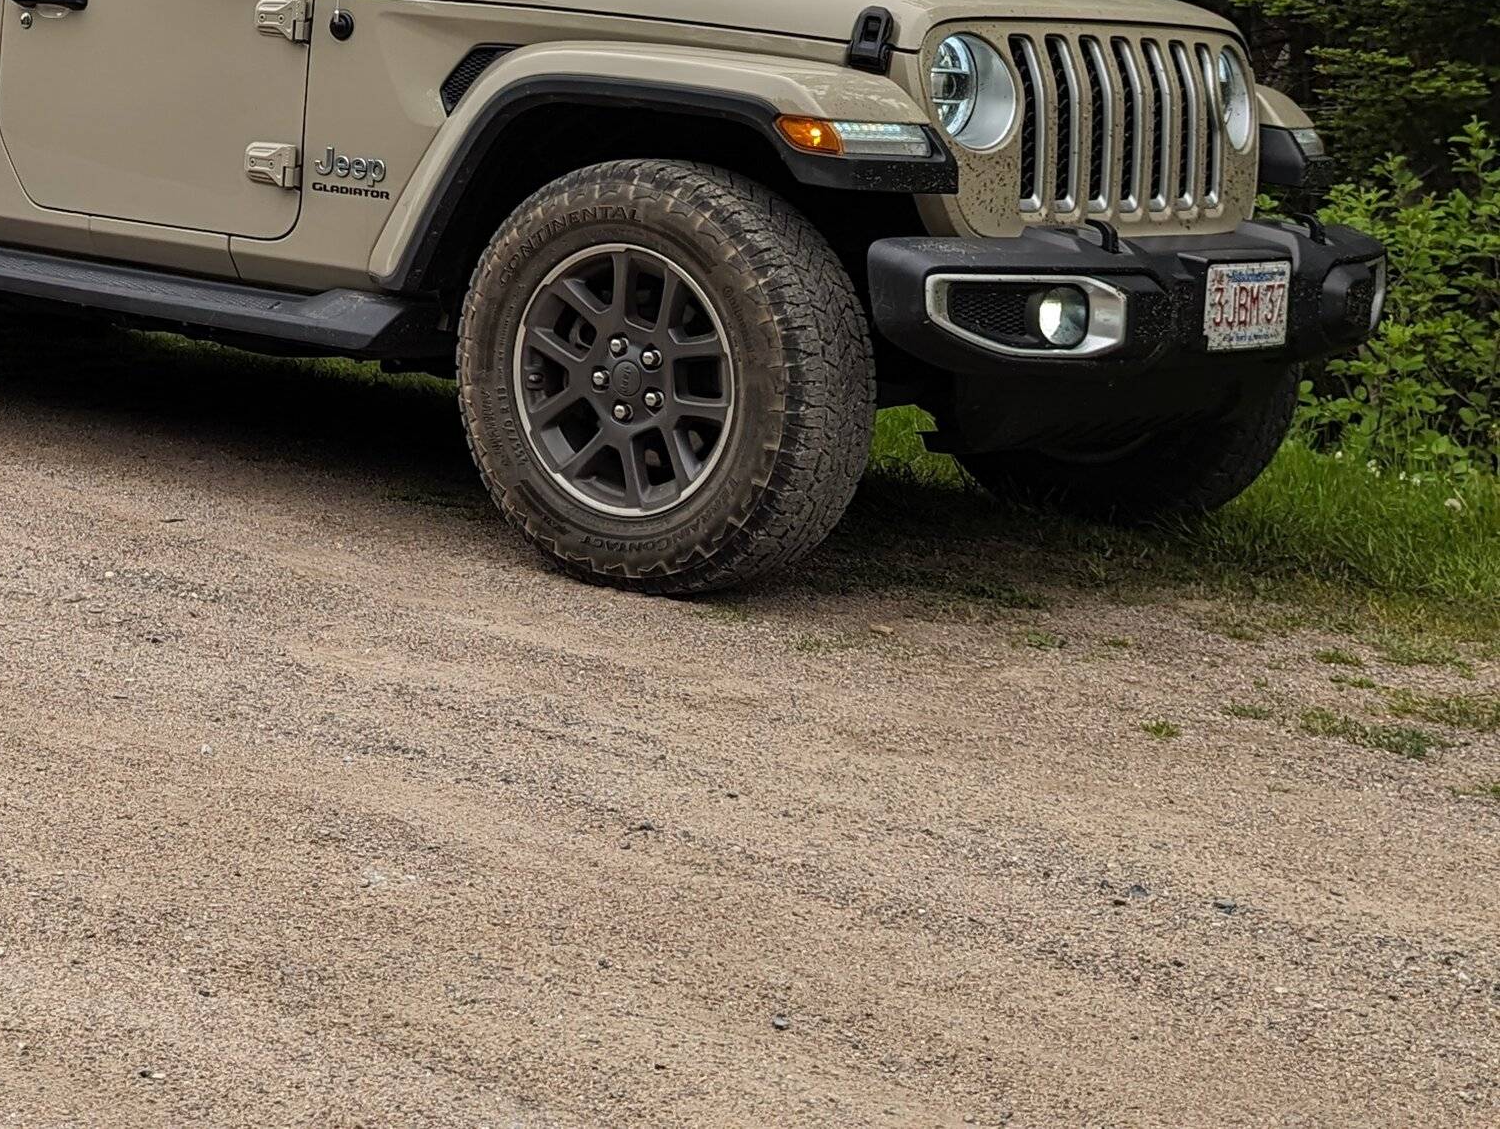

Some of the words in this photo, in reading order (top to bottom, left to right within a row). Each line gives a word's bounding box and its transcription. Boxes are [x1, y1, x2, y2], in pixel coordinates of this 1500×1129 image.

[314, 146, 386, 187] Jeep
[312, 182, 390, 200] GLADIATOR
[499, 205, 642, 286] CONTINENTAL
